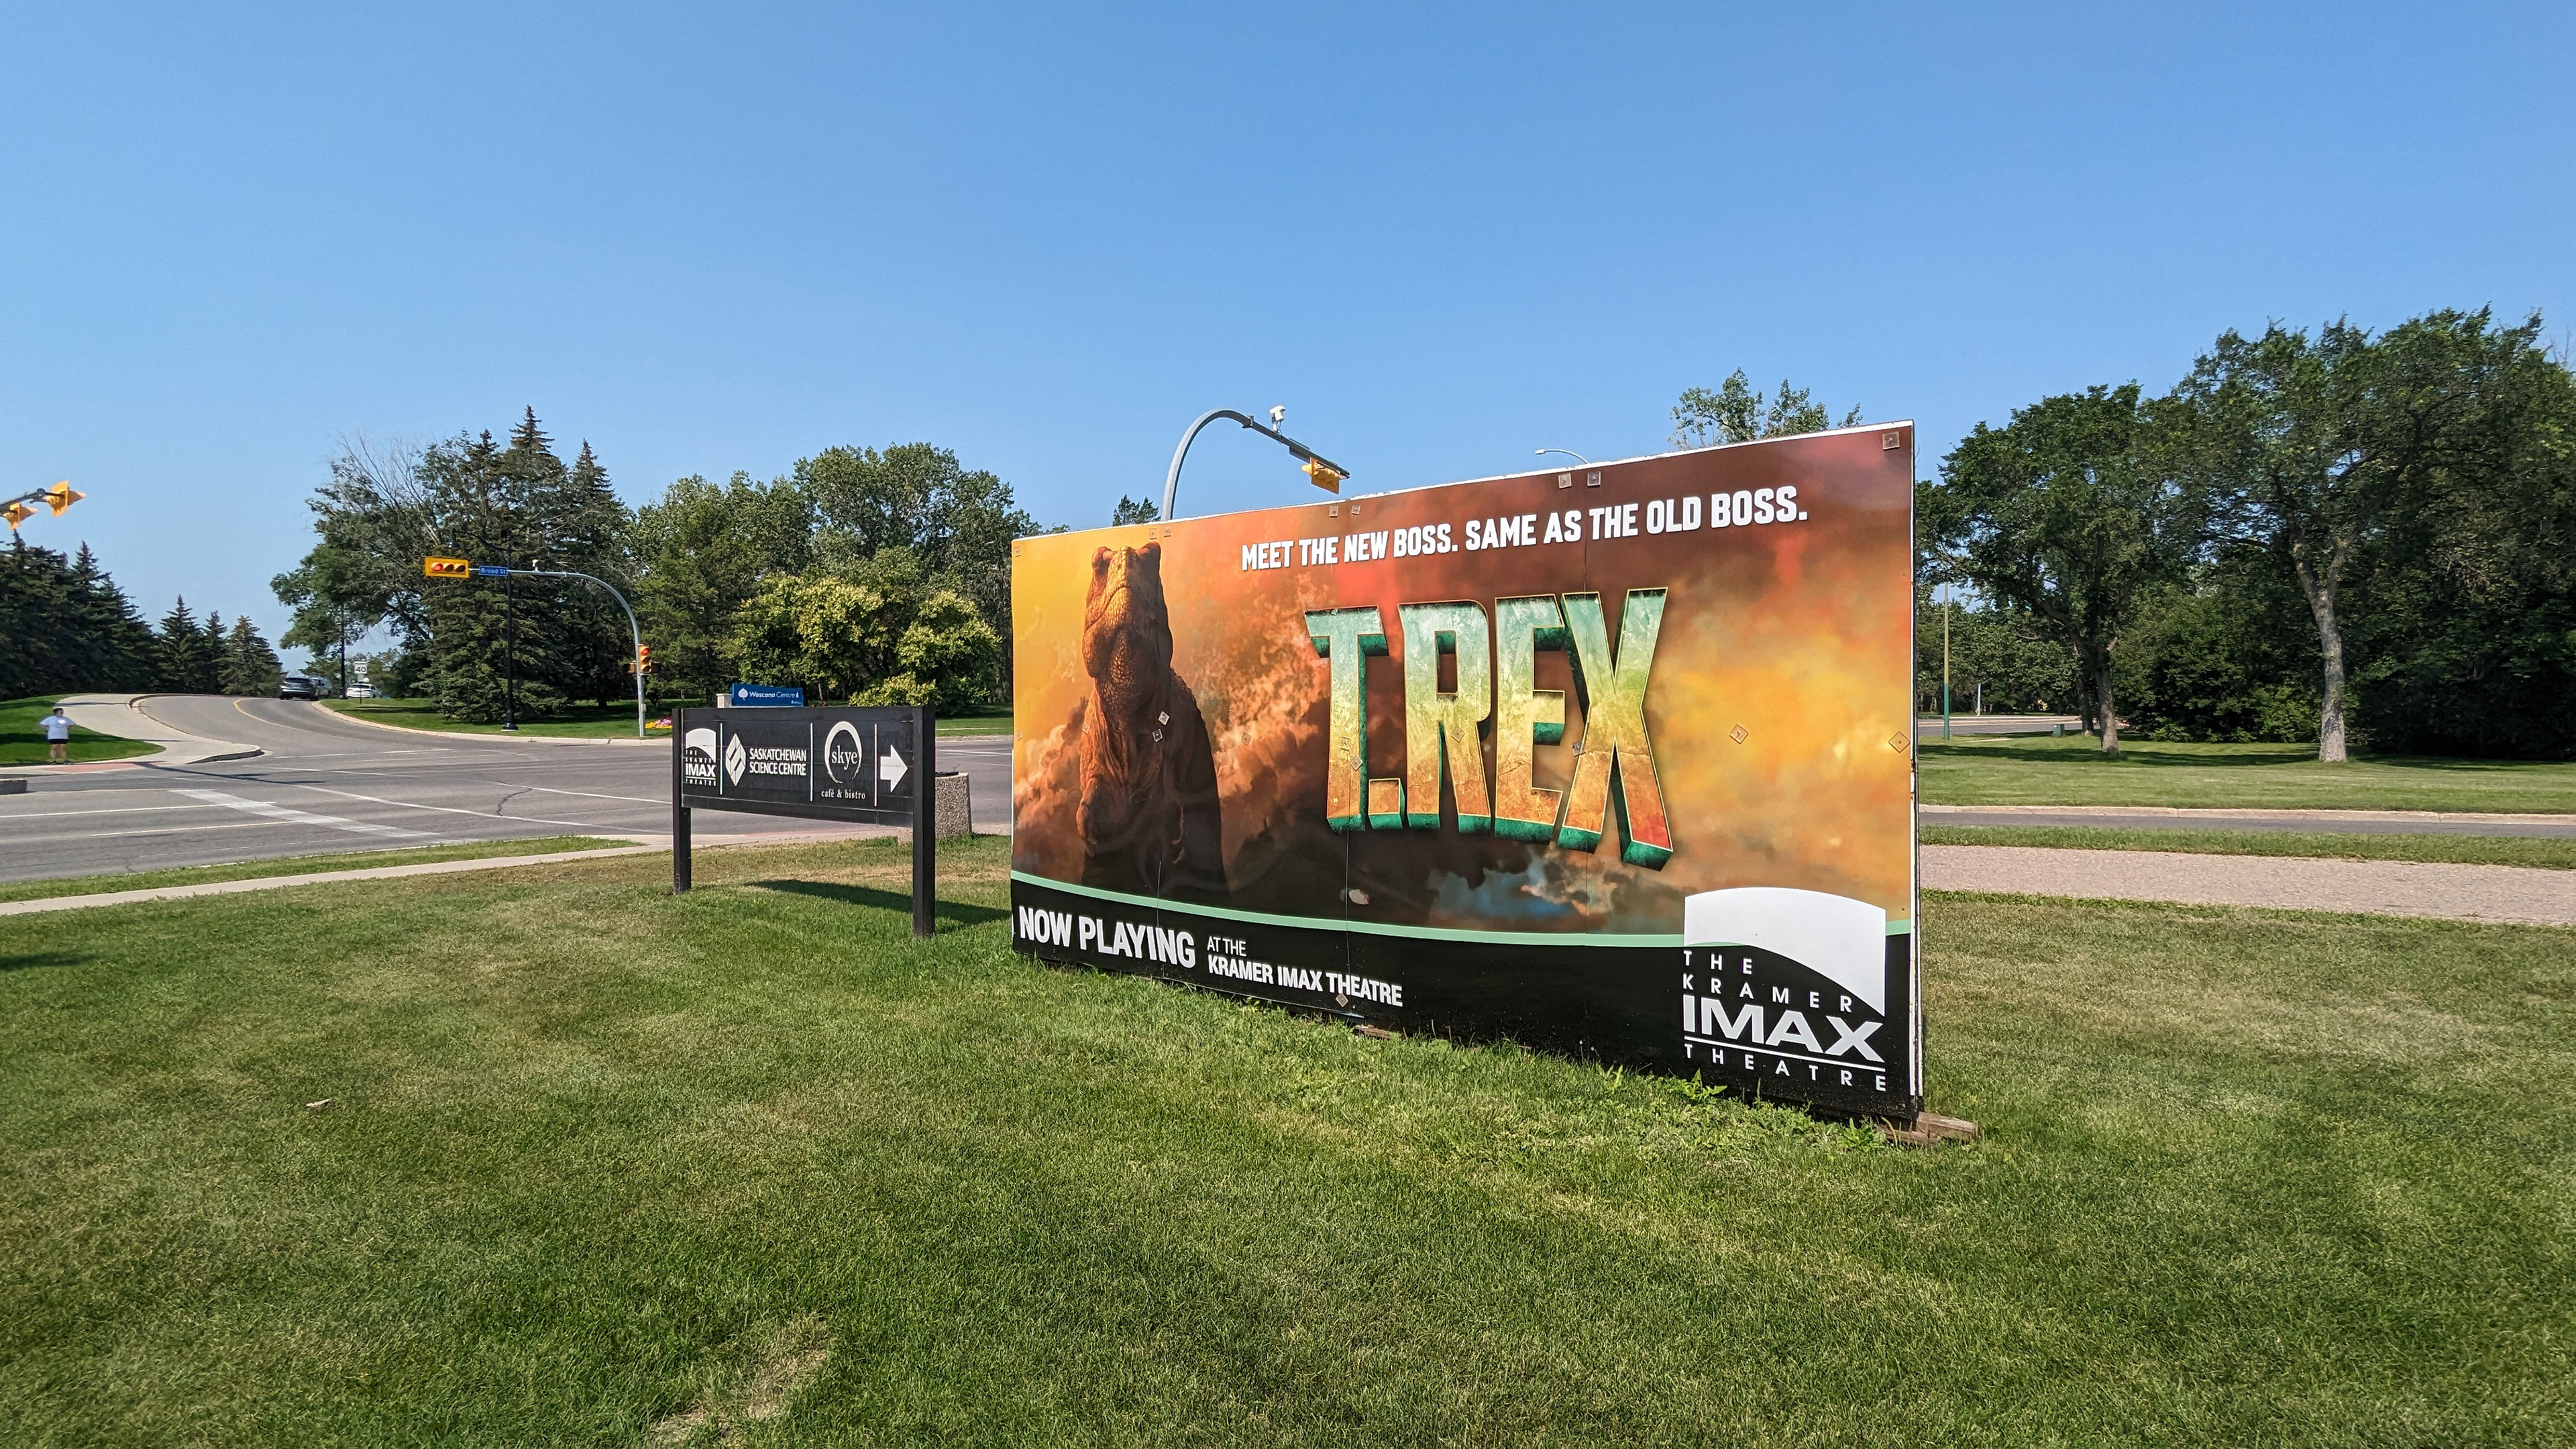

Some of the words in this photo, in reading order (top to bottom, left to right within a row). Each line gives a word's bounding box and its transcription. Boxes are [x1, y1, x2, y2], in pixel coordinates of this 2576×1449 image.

[1242, 540, 1294, 571] MEET
[1299, 536, 1339, 566] THE
[1344, 530, 1389, 563] NEW
[1393, 523, 1458, 557] BOSS.
[1465, 514, 1538, 551] SAME
[1543, 510, 1582, 544] AS
[1589, 503, 1639, 540] THE
[1646, 496, 1702, 535] OLD
[1711, 485, 1808, 529] BOSS.
[1304, 587, 1673, 871] T.REX
[749, 747, 807, 761] SASKATCHEWAN
[831, 745, 858, 771] skye
[686, 763, 716, 777] IMAX
[749, 761, 778, 775] SCIENCE
[778, 762, 807, 776] CENTRE
[686, 778, 716, 786] THEATRE
[821, 788, 835, 798] café
[837, 789, 843, 798] &
[845, 788, 866, 800] bistro
[1019, 906, 1073, 948] NOW
[1078, 916, 1196, 969] PLAYING
[1207, 936, 1221, 953] AT
[1222, 938, 1247, 957] THE
[1682, 949, 1752, 975] THE
[1208, 955, 1274, 985] KRAMER
[1277, 965, 1324, 992] IMAX
[1326, 972, 1403, 1007] THEATRE
[1682, 973, 1852, 1013] KRAMER
[1682, 994, 1886, 1063] IMAX
[1684, 1043, 1886, 1092] THEATRE
